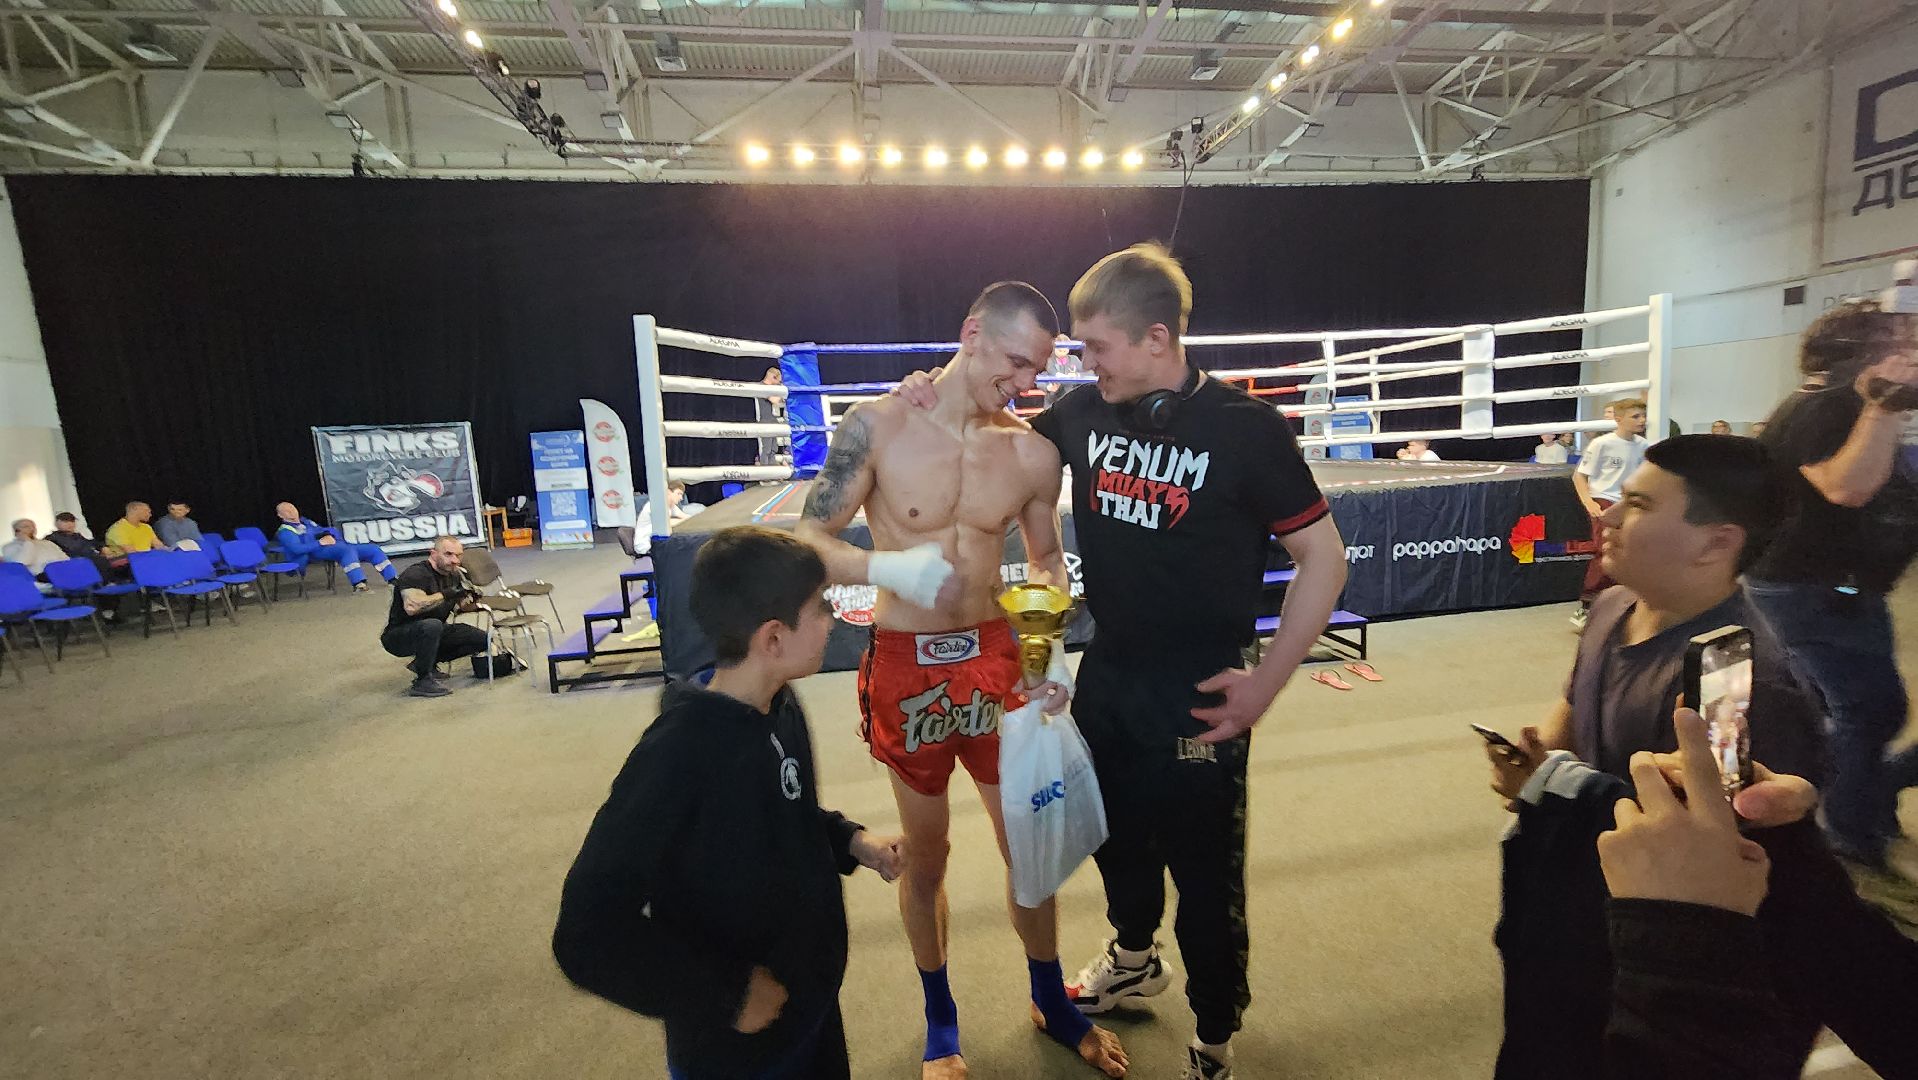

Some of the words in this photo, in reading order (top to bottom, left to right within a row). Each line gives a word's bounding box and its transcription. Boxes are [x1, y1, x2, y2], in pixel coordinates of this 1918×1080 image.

[329, 431, 459, 454] FINKS
[1088, 430, 1210, 492] VENUM
[1097, 469, 1168, 503] MUAY
[1097, 490, 1161, 529] THAI
[342, 514, 470, 544] RUSSIA
